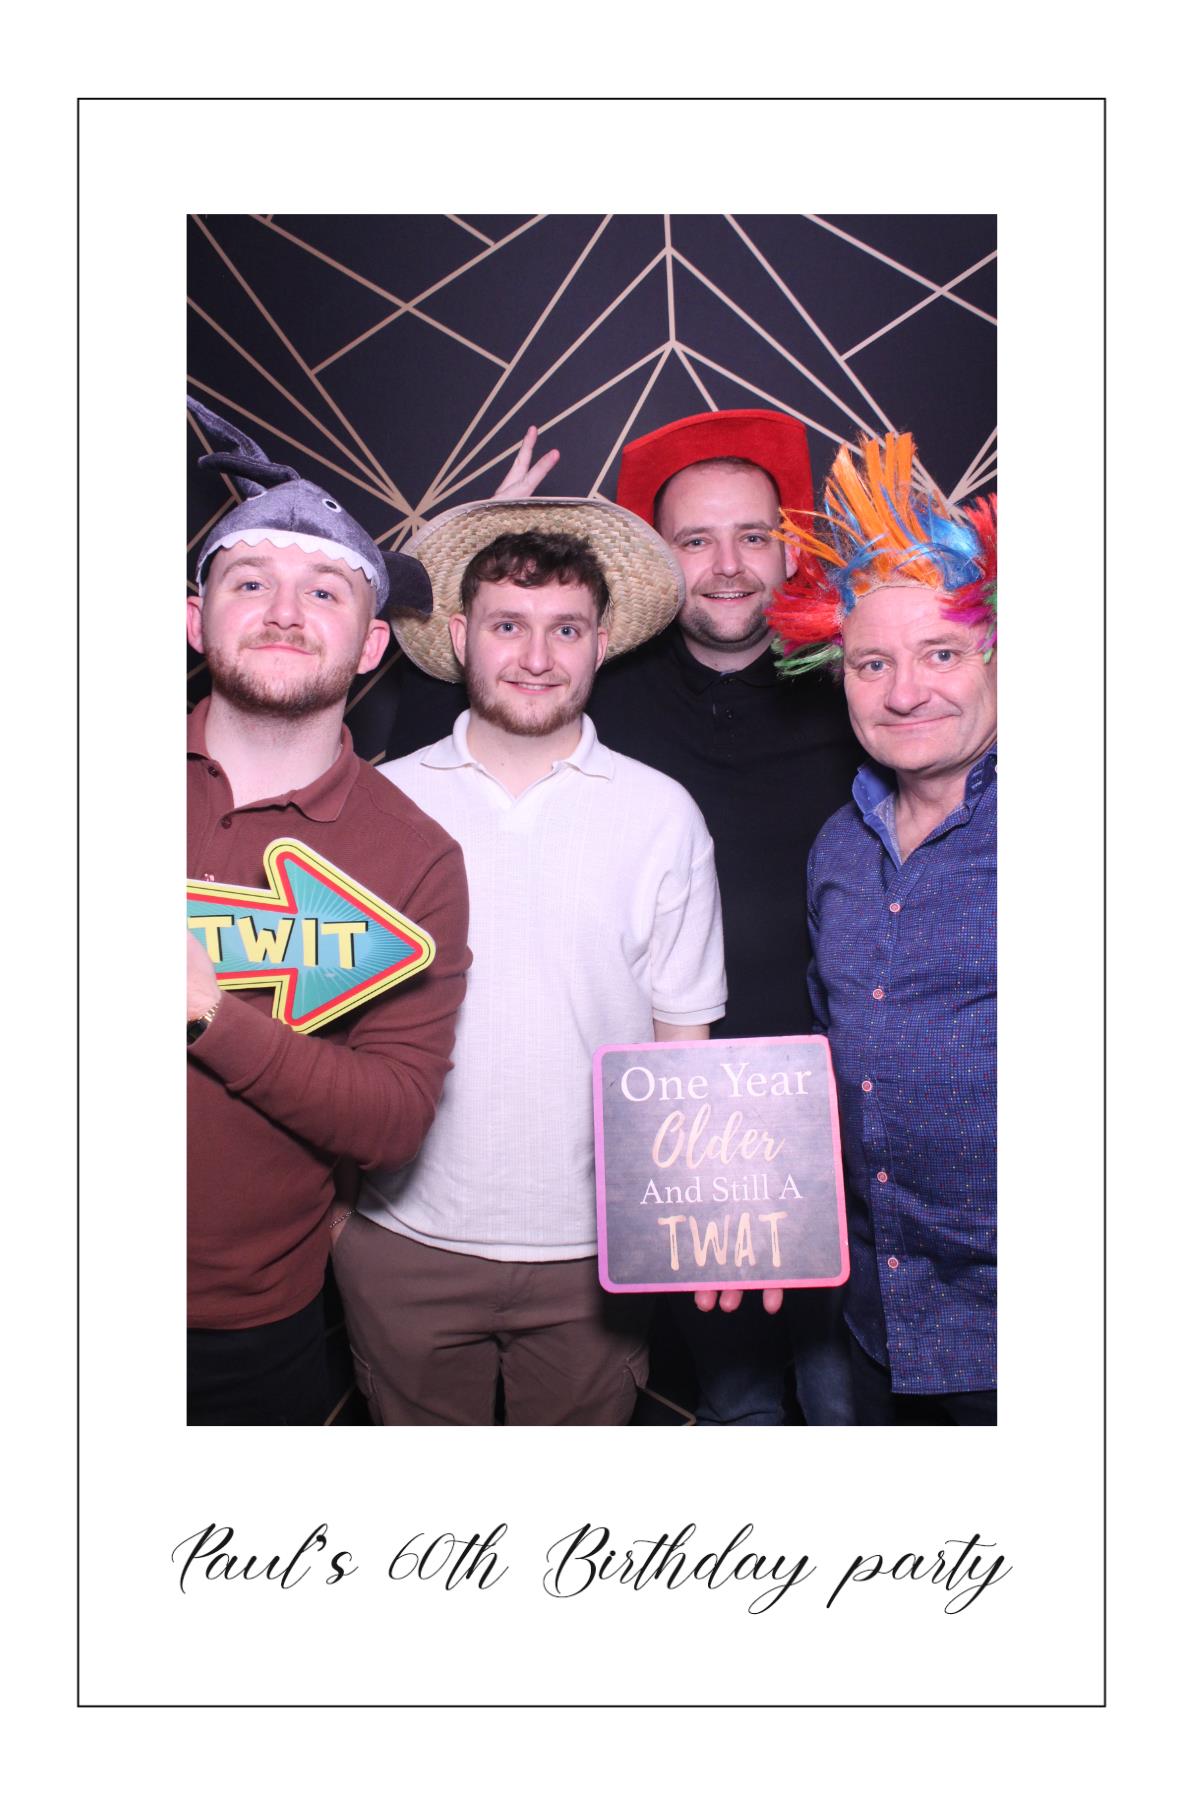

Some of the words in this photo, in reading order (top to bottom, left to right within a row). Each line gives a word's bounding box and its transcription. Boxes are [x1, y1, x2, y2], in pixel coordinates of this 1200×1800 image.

[187, 914, 369, 969] TWIT
[620, 1066, 709, 1102] One
[720, 1062, 812, 1098] Year
[652, 1103, 786, 1169] Older
[640, 1177, 701, 1205] And
[712, 1173, 769, 1202] Still
[778, 1173, 804, 1200] A
[657, 1211, 788, 1271] TWAT
